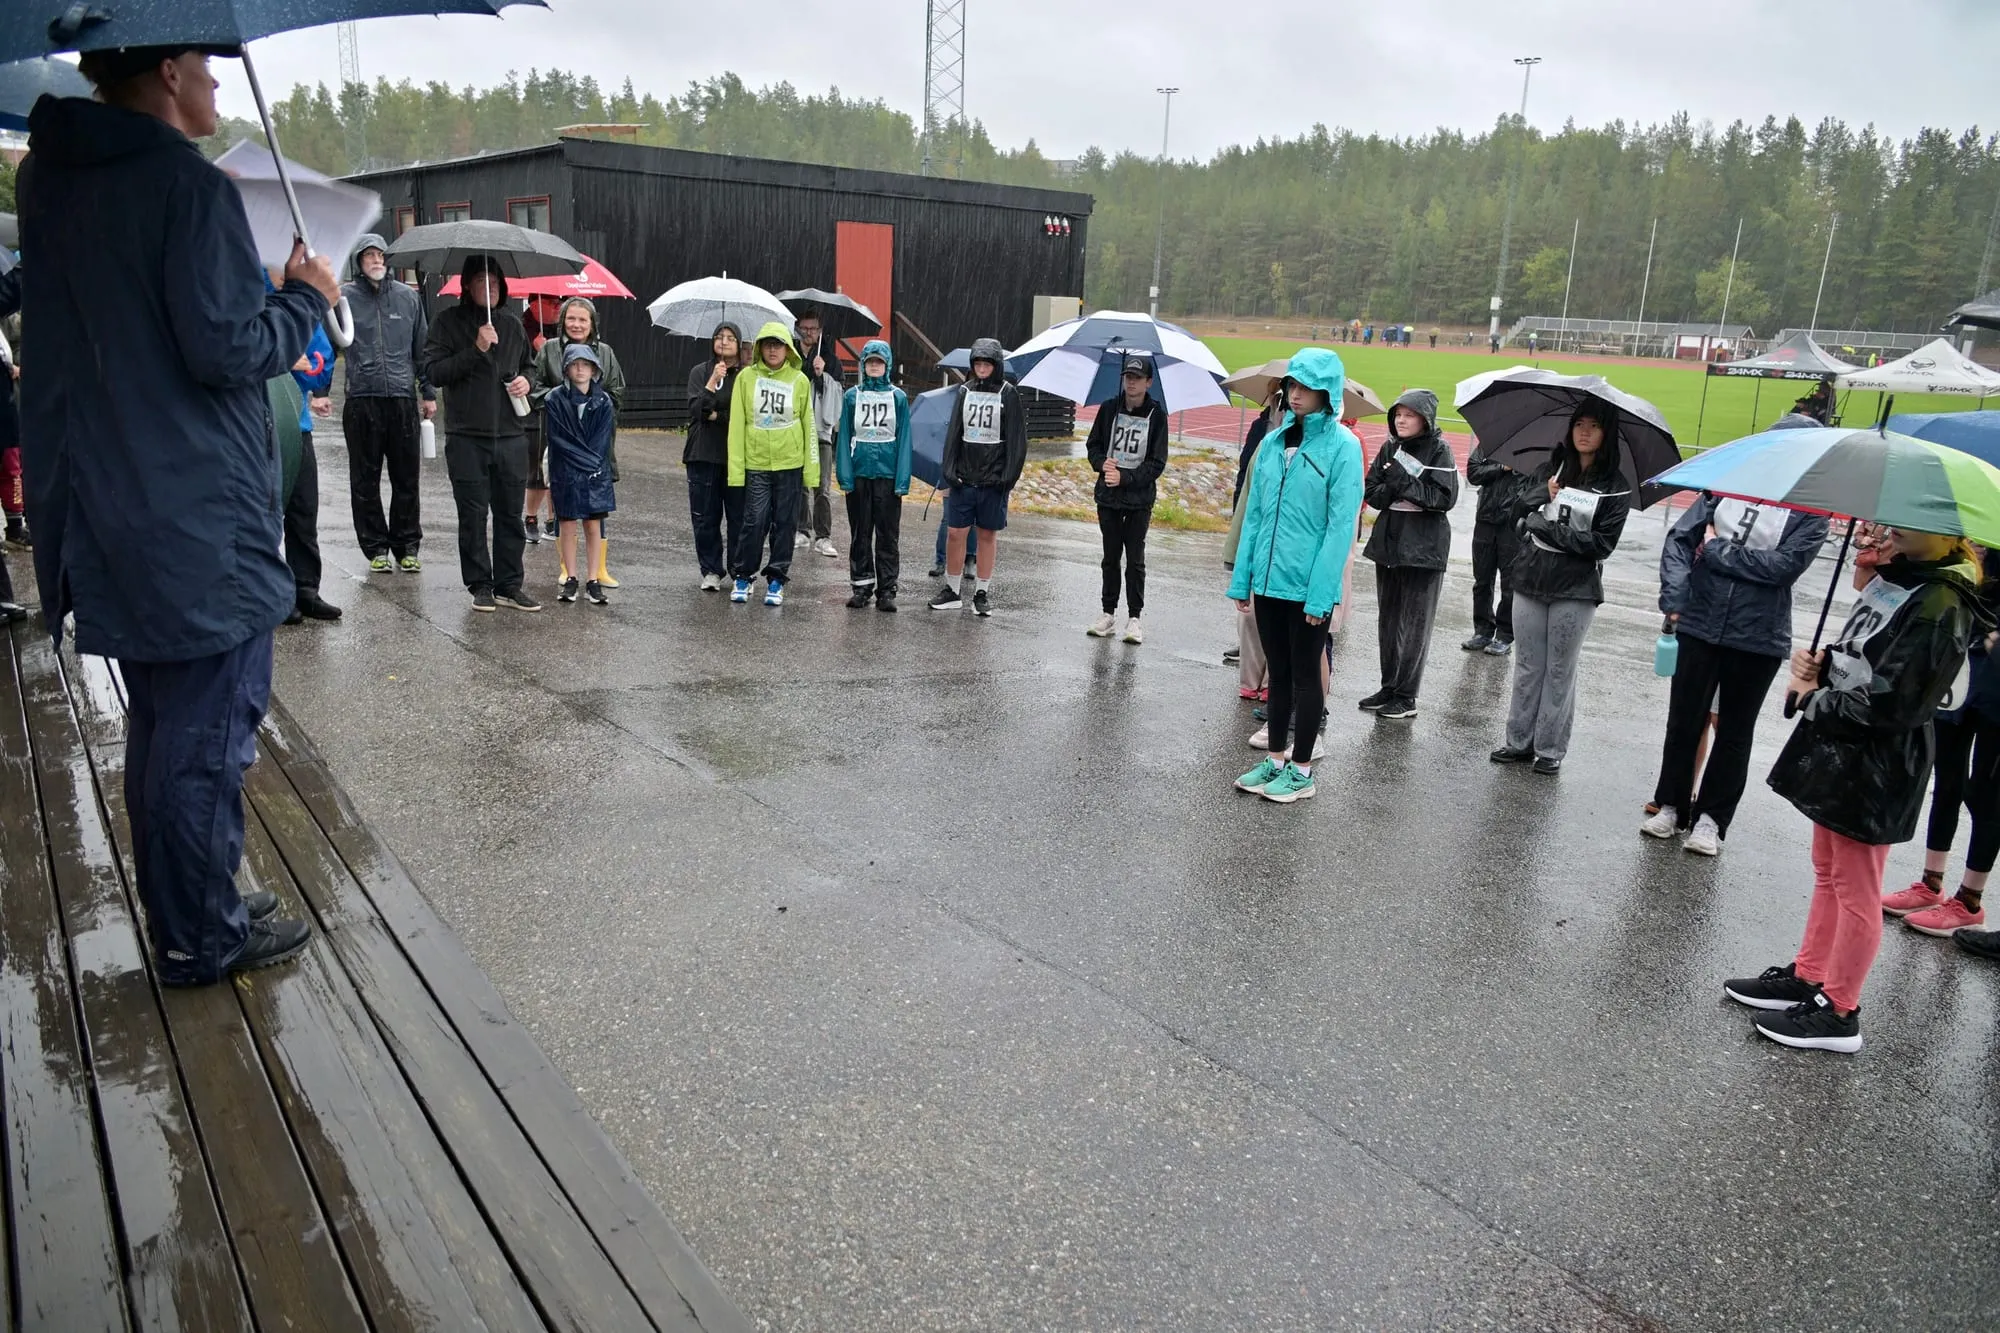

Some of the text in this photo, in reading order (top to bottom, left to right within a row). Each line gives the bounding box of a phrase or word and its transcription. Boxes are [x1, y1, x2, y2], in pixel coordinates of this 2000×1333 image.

[1727, 367, 1764, 377] 24MX
[1784, 371, 1824, 380] 24MX
[760, 389, 786, 415] 219
[861, 403, 888, 427] 212
[967, 403, 994, 429] 213
[1113, 426, 1142, 454] 215
[1731, 507, 1760, 546] 9
